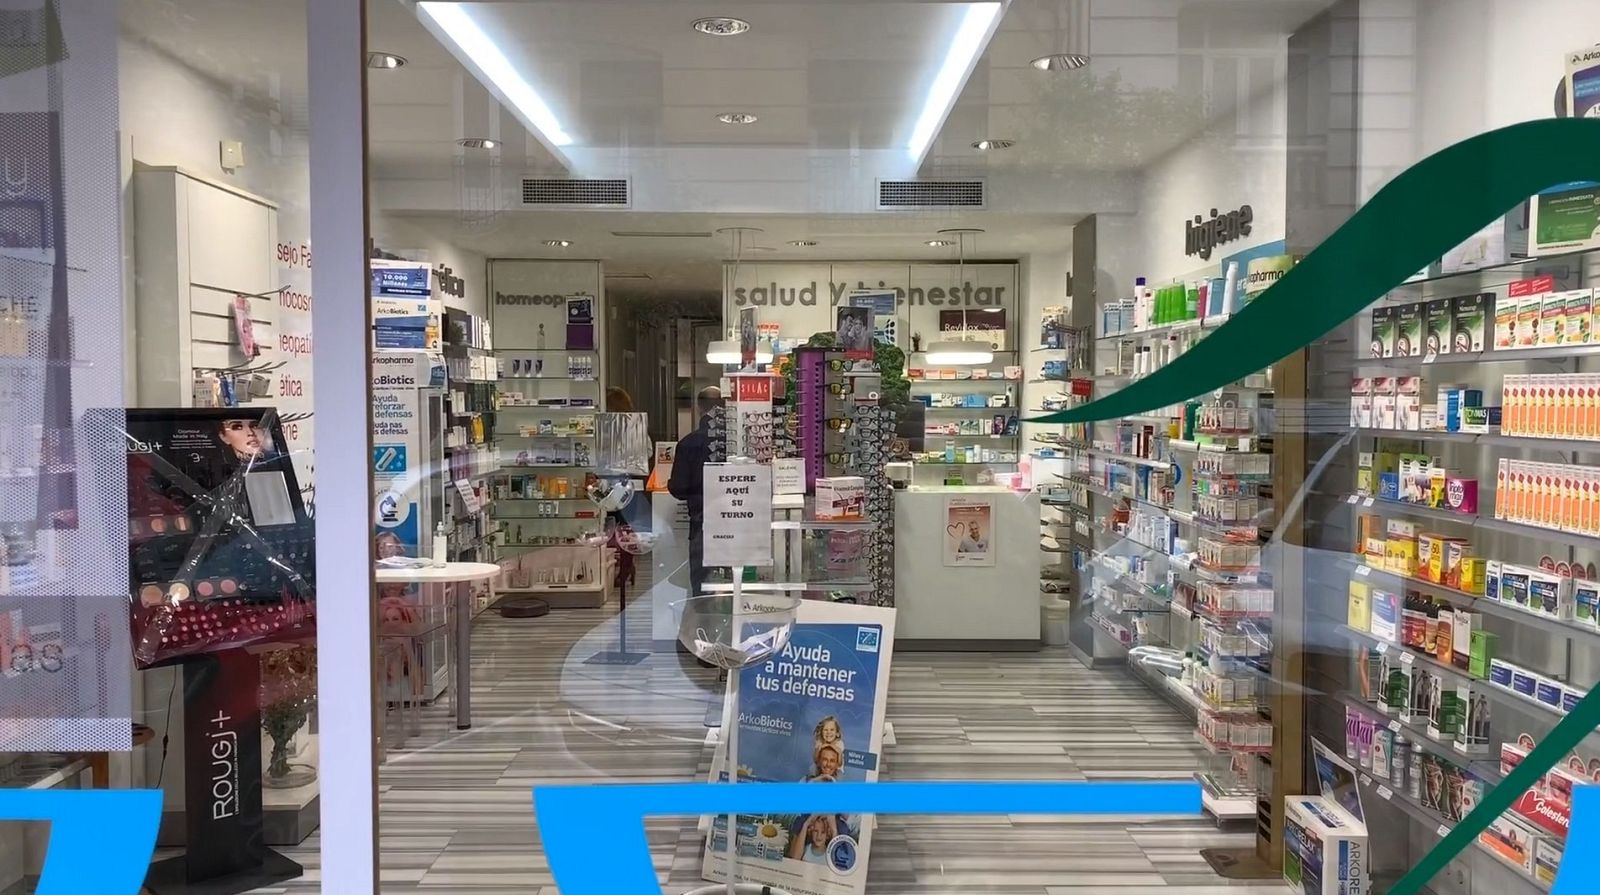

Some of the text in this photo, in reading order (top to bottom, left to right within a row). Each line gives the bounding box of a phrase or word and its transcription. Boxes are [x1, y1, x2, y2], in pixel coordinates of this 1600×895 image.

[1185, 205, 1253, 261] higiene
[495, 291, 567, 308] homeop
[735, 282, 817, 306] salud
[858, 281, 1005, 306] nestar
[372, 357, 415, 365] rkopharma
[372, 375, 415, 385] oBiotics
[725, 487, 749, 495] AQUÍ
[720, 511, 754, 519] TURNO
[781, 641, 831, 663] Ayuda
[764, 660, 857, 684] a mantener
[755, 674, 855, 702] tus defensas
[738, 712, 793, 730] ArkoBiotics
